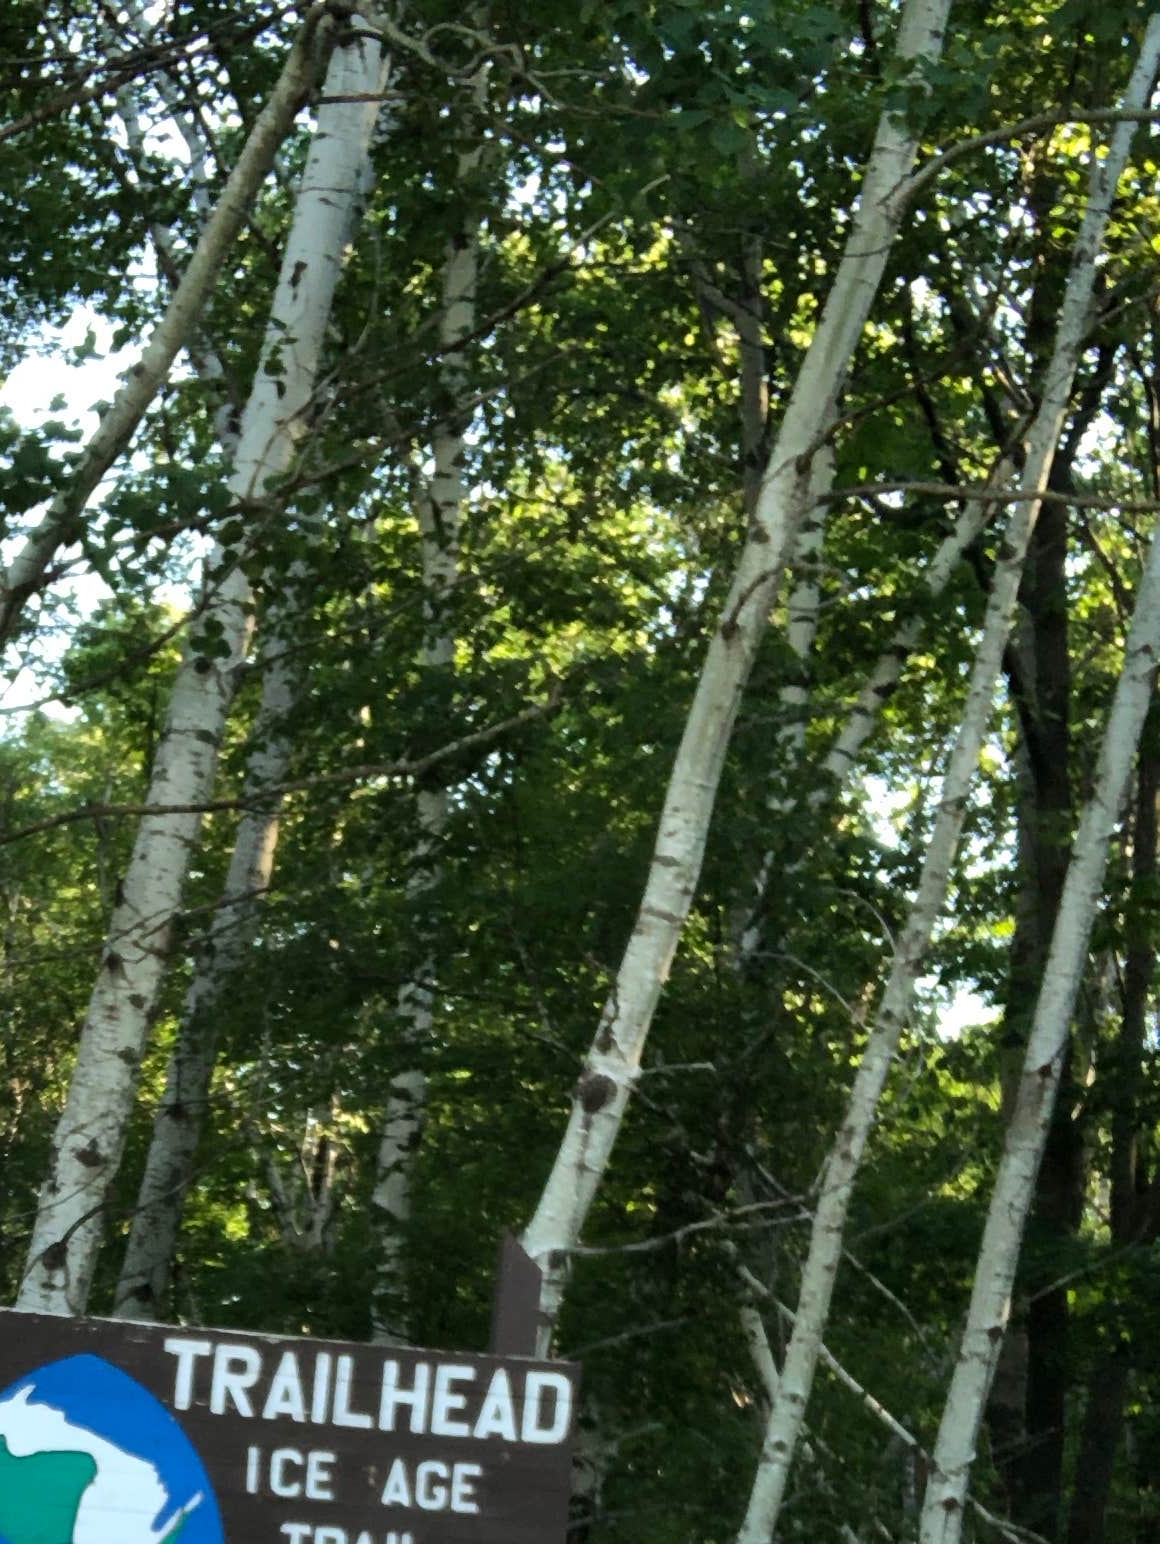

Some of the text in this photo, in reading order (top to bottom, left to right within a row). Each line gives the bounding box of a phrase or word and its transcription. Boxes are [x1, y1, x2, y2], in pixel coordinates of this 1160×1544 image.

[164, 1337, 573, 1445] TRAILHEAD
[246, 1446, 483, 1514] ICE AGE
